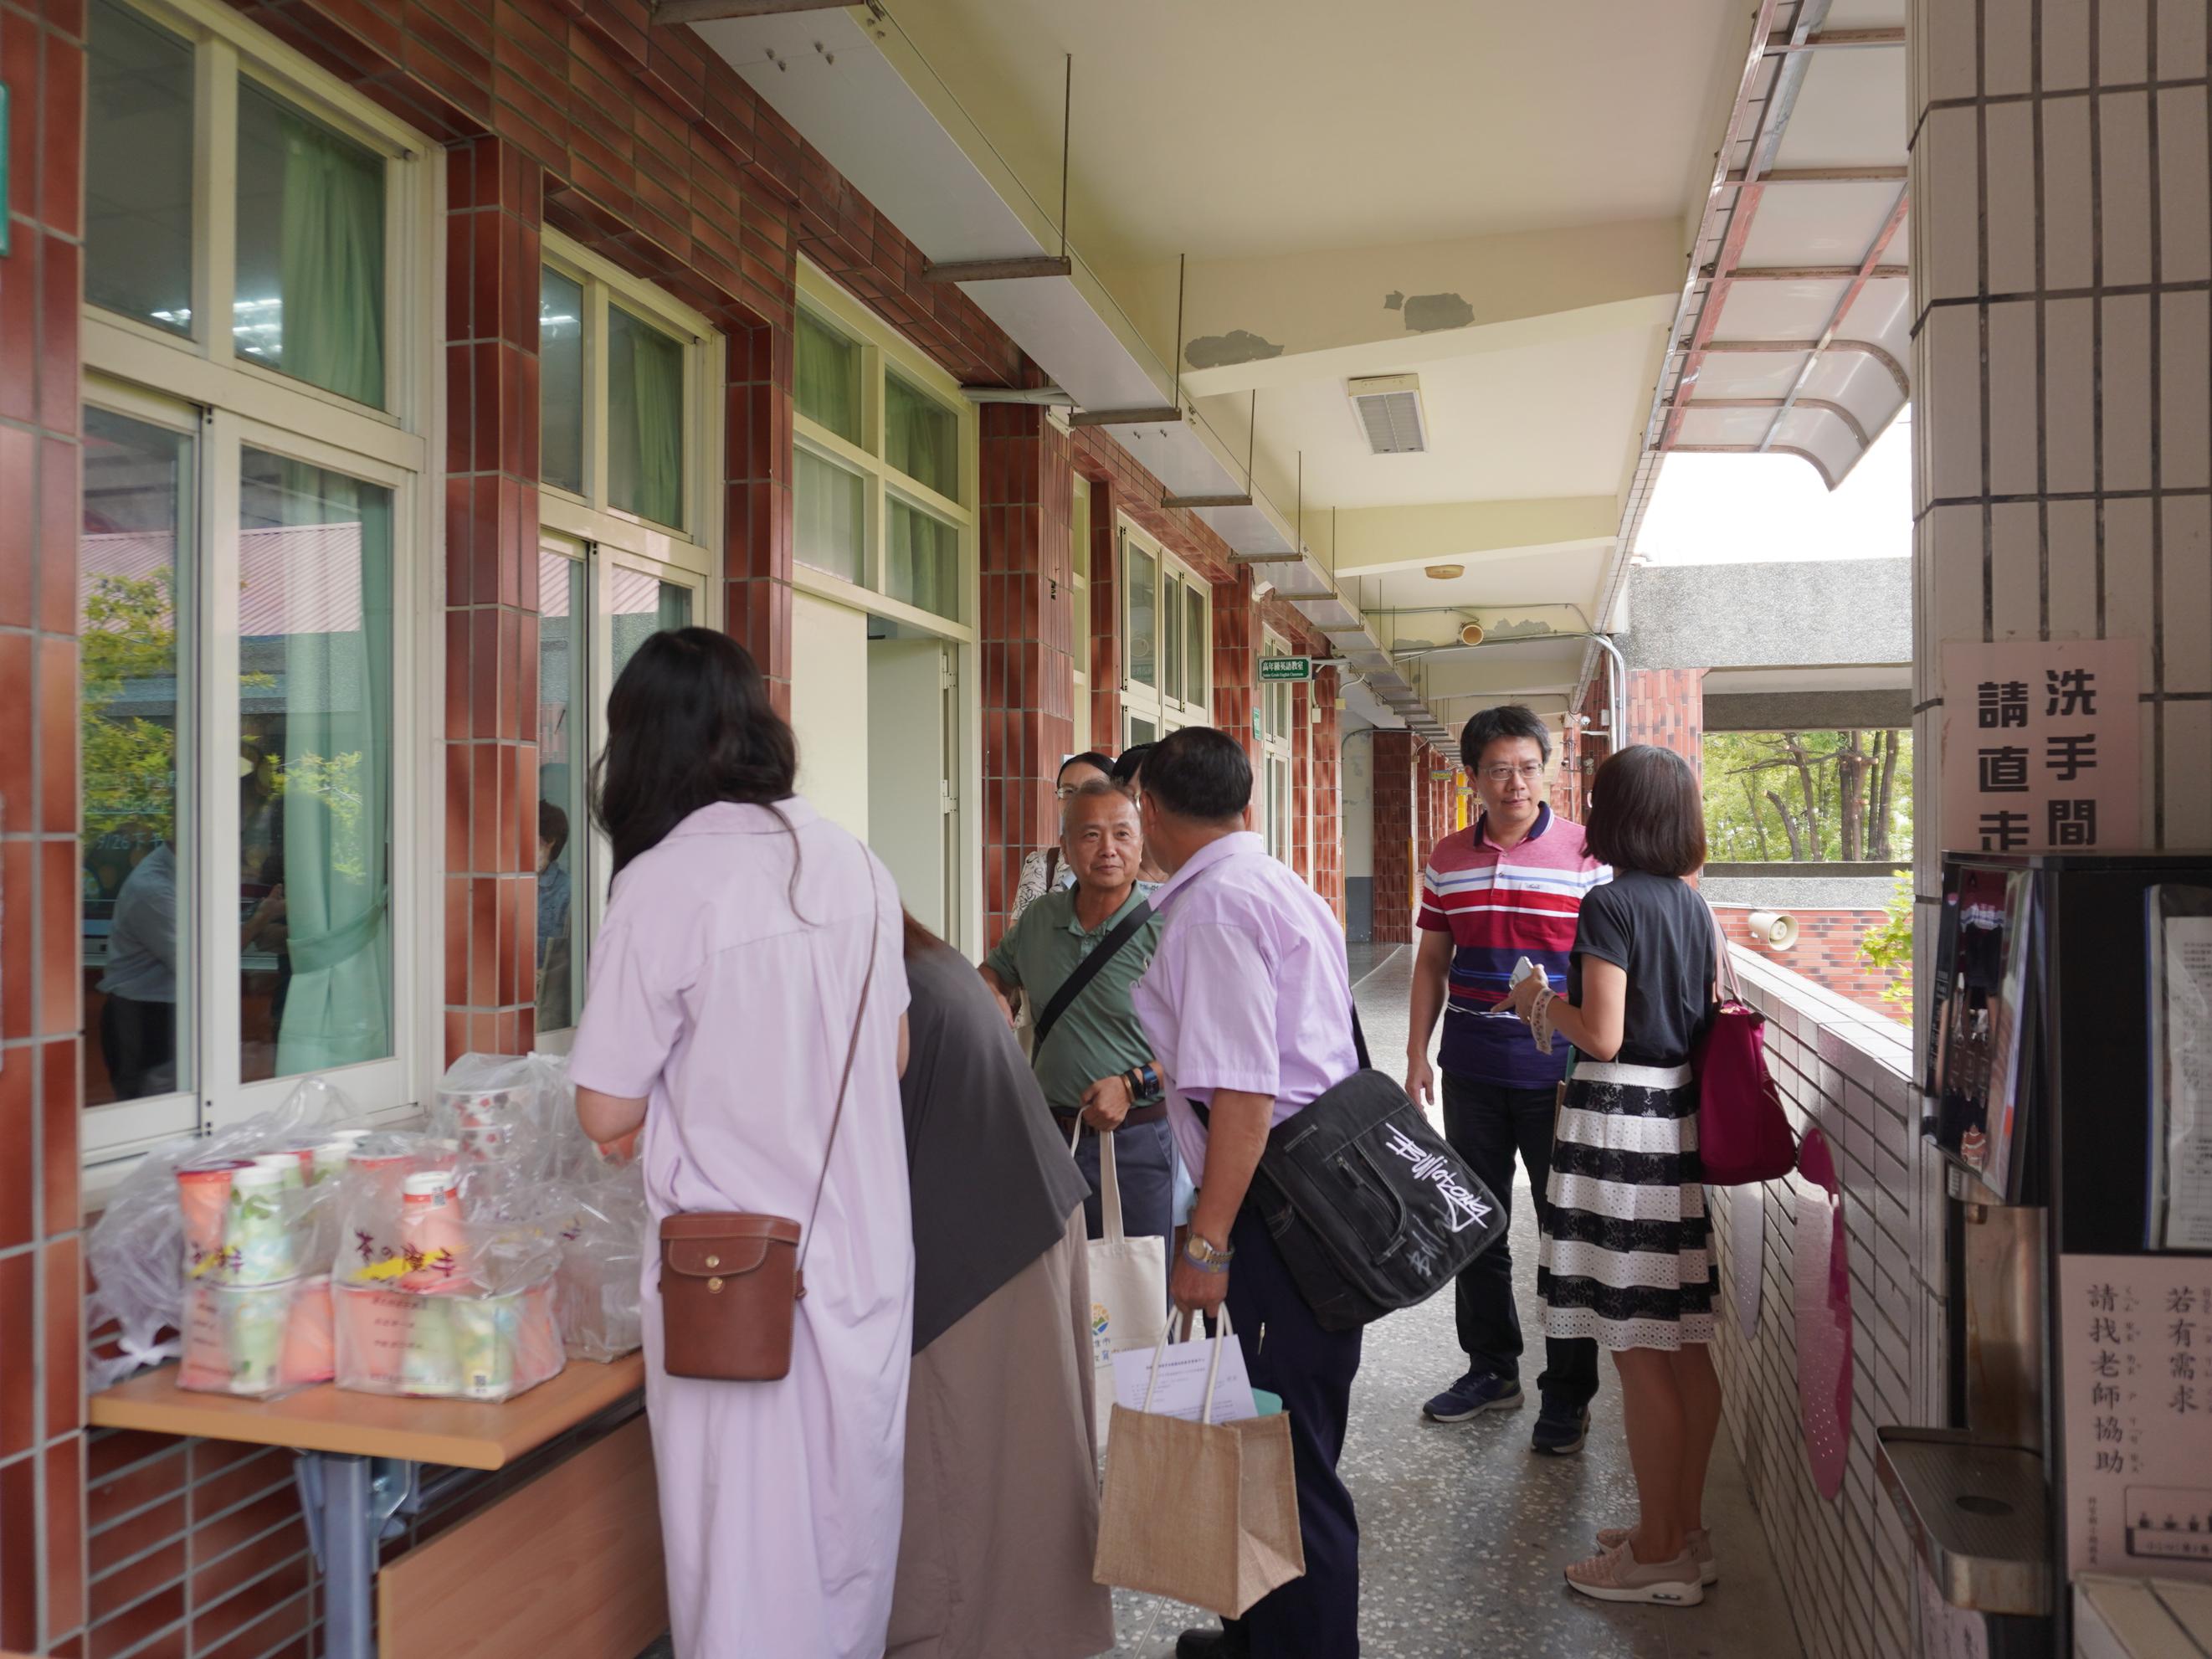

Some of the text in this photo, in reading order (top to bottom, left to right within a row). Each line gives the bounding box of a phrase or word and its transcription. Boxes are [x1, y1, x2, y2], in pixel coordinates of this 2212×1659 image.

[1978, 681, 2030, 850] 請直走
[2046, 669, 2097, 845] 洗手間
[2086, 1283, 2124, 1474] 請找老師協助
[2165, 1286, 2199, 1415] 若有需求
